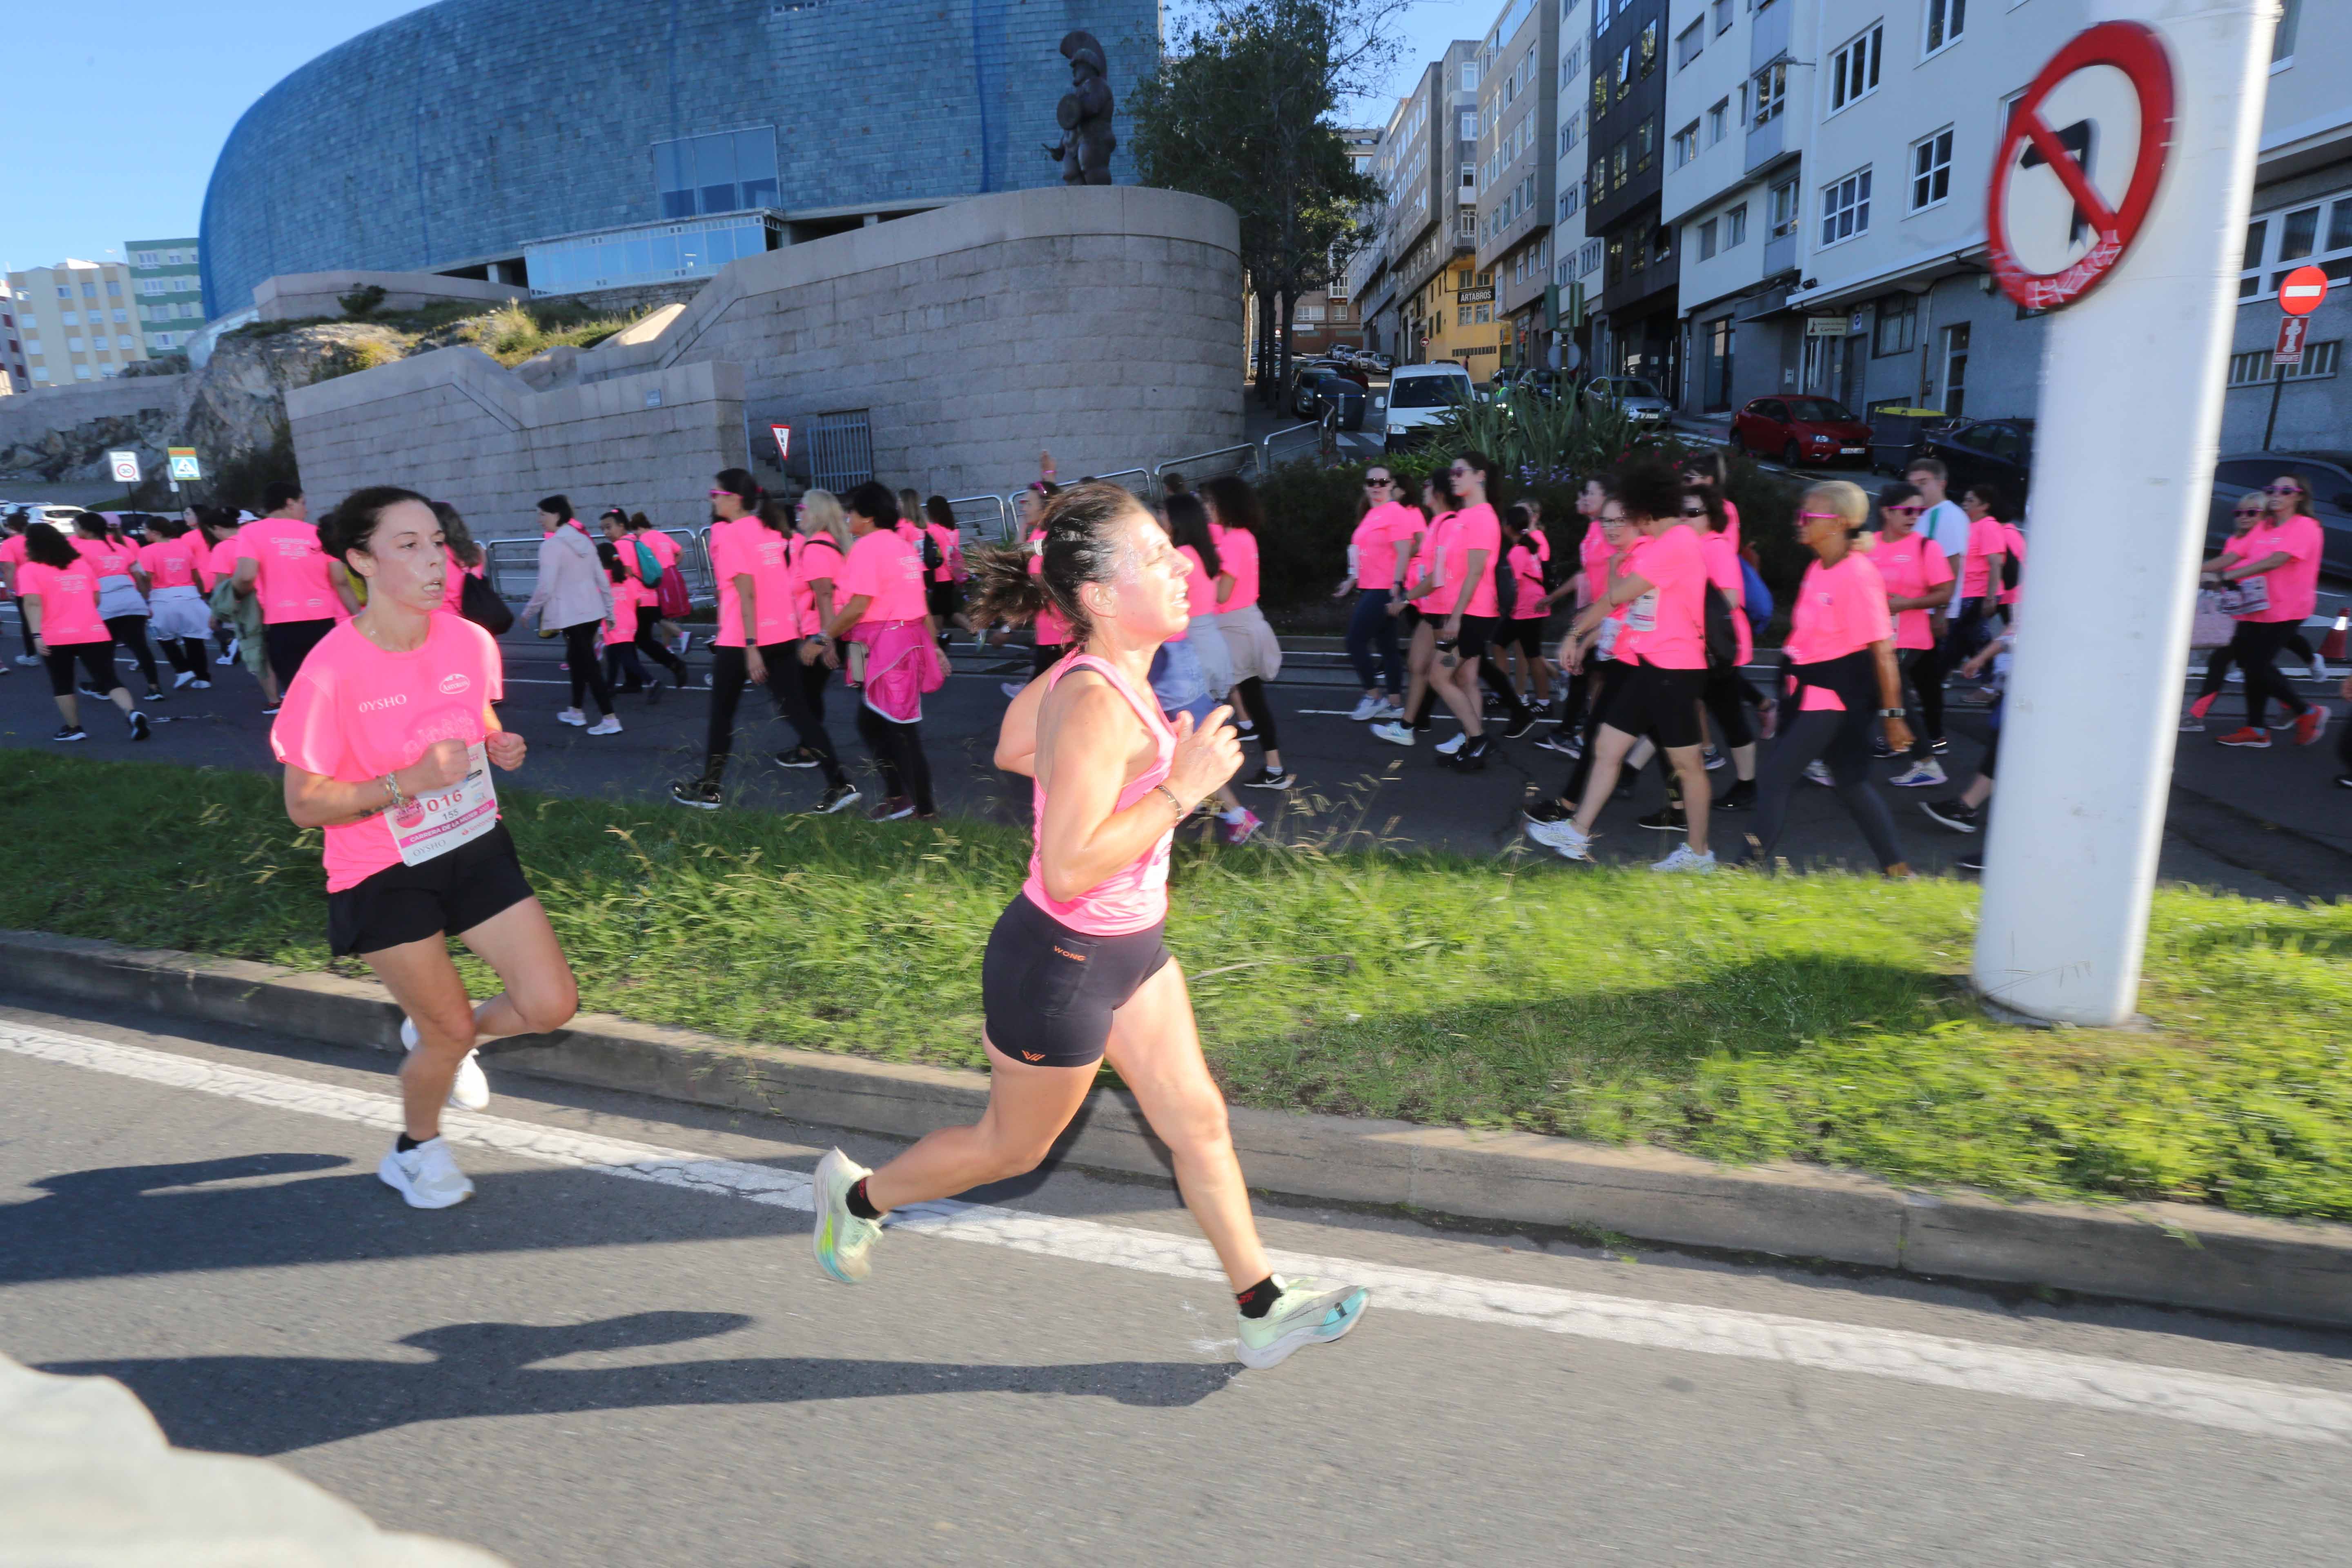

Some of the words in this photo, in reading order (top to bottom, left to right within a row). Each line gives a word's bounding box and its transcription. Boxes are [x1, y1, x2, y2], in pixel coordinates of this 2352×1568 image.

[1461, 291, 1492, 302] ARTABROS
[359, 694, 407, 713] OYSHO
[442, 809, 459, 821] 155
[410, 828, 441, 843] CARRERA
[441, 823, 451, 832] DE
[451, 819, 460, 828] LA
[413, 839, 446, 857] OYSHO
[1054, 945, 1086, 961] WONG
